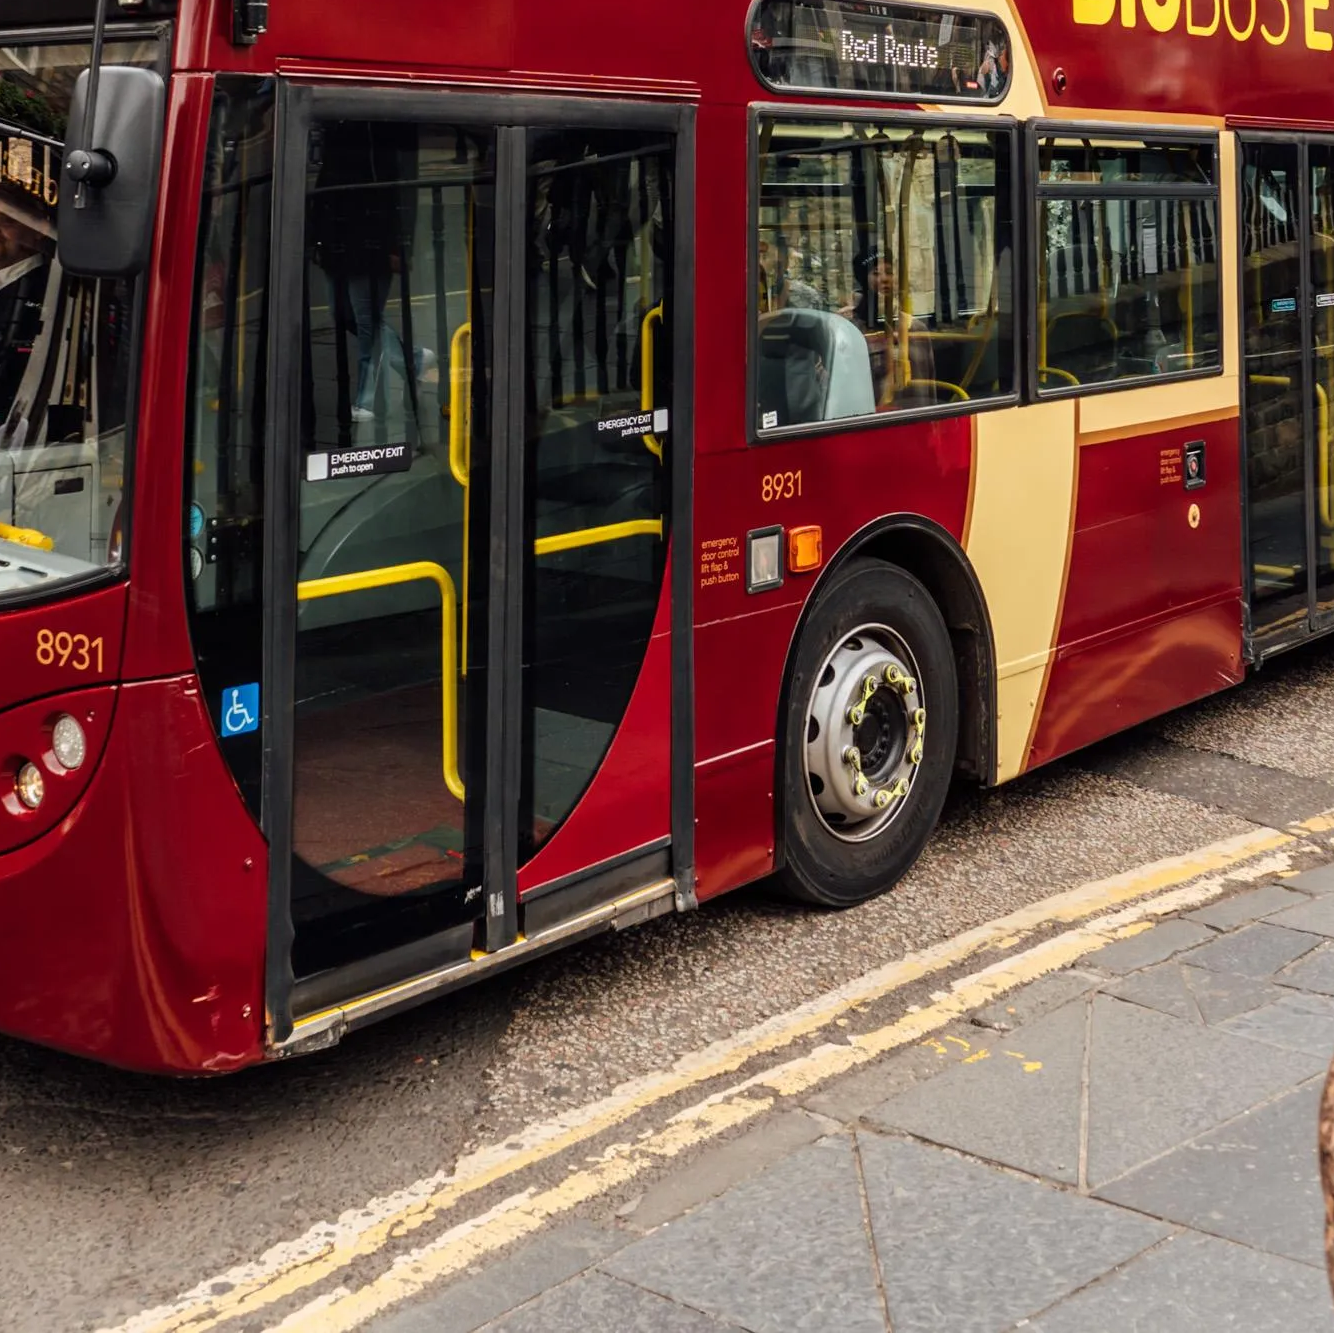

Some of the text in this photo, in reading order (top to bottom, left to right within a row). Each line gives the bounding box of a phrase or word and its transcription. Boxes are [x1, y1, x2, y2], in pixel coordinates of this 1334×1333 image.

[842, 30, 938, 68] Red Route
[598, 414, 652, 431] EMERGENCY EXIT
[621, 427, 634, 437] push
[331, 446, 405, 465] EMERGENCY EXIT
[331, 463, 374, 477] push to open
[762, 470, 802, 502] 8931
[701, 537, 737, 550] emergency
[701, 547, 740, 562] door control
[701, 572, 740, 589] push button
[36, 629, 103, 673] 8931
